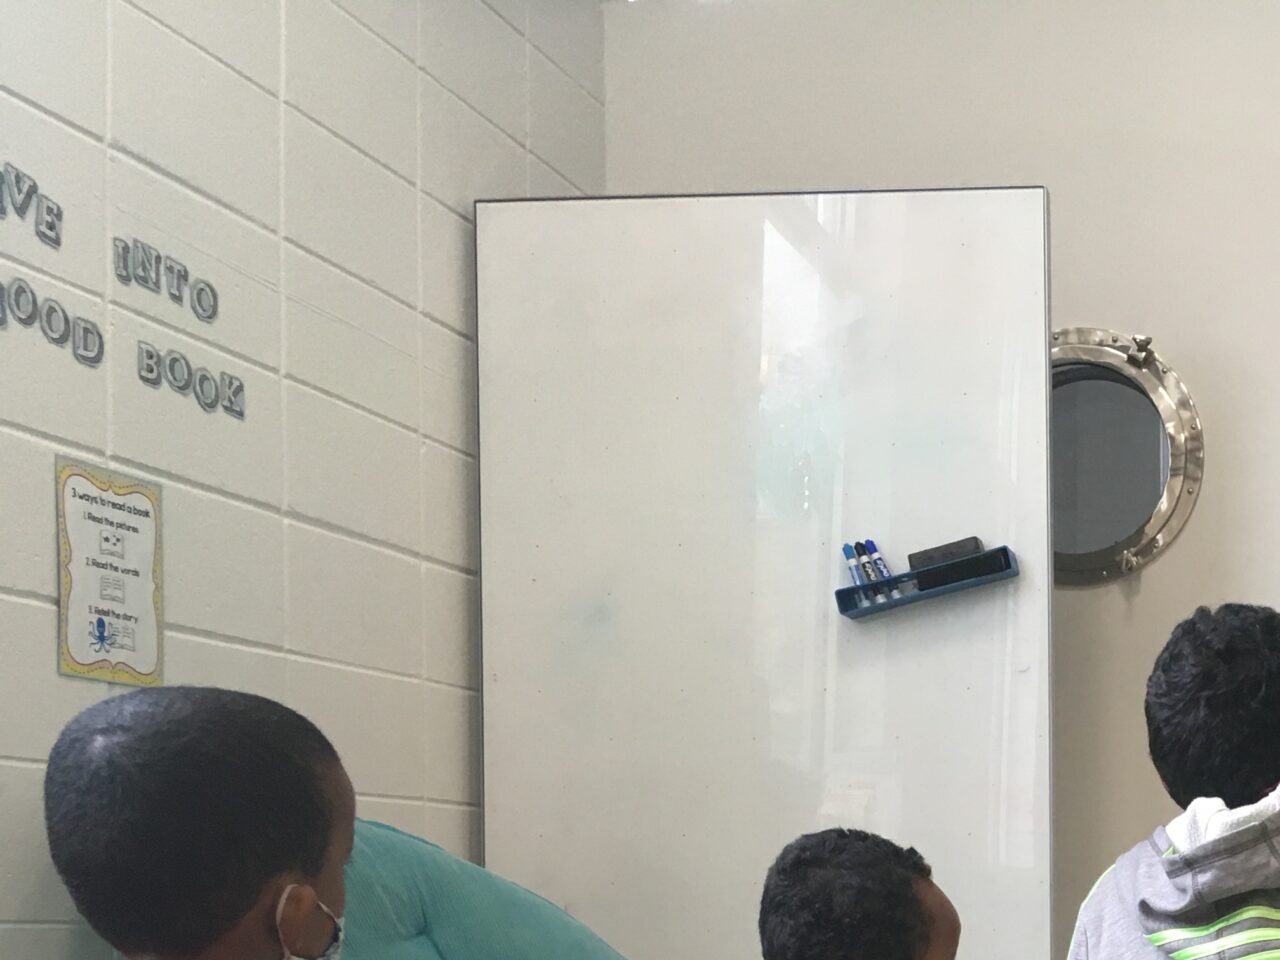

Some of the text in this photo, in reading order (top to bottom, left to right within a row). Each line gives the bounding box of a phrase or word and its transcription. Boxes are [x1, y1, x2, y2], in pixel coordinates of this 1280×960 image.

[112, 237, 218, 323] INTO
[137, 340, 245, 421] BOOK
[87, 512, 104, 525] Read
[106, 500, 126, 512] read
[132, 505, 151, 519] book
[91, 558, 108, 570] Read
